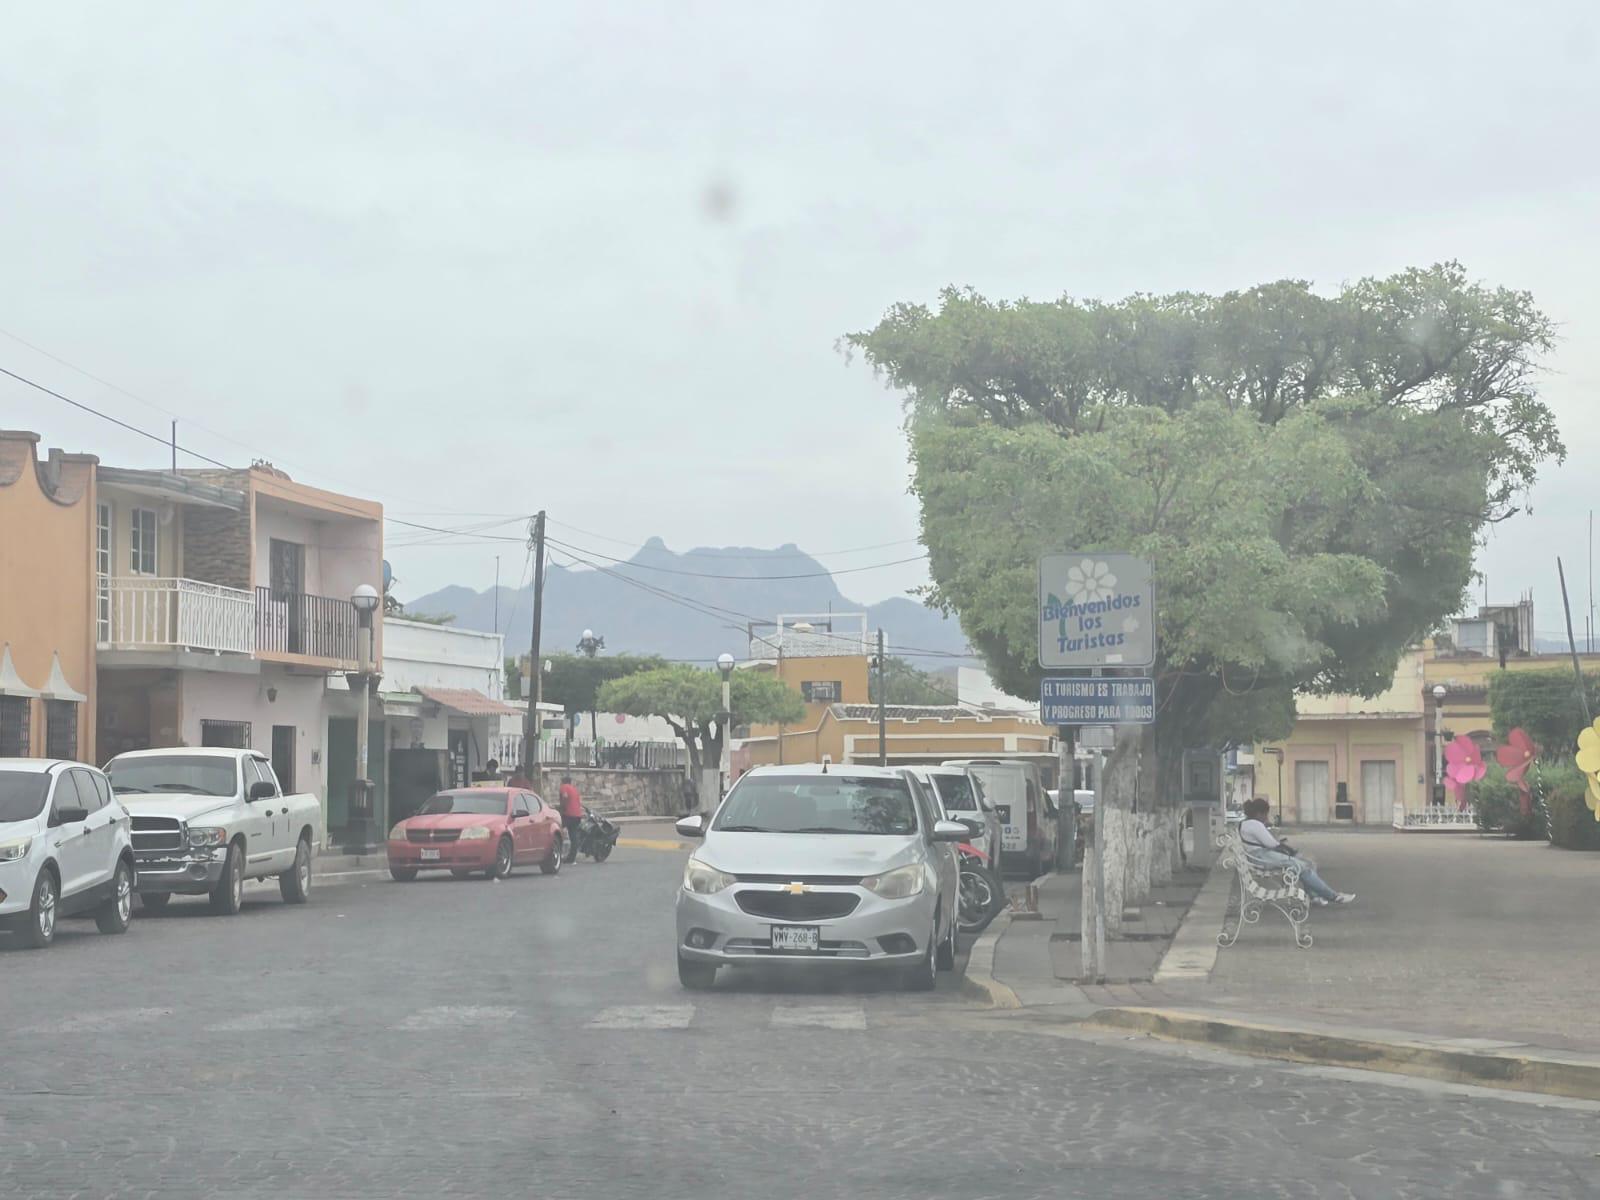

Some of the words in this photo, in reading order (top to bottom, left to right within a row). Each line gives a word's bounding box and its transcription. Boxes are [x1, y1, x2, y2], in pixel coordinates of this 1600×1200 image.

[1043, 594, 1140, 621] Bienvenidos
[1078, 615, 1102, 632] los
[1057, 632, 1125, 653] Turistas
[1044, 683, 1053, 697] EL
[1056, 683, 1095, 697] TURISMO
[1098, 683, 1108, 697] ES
[1112, 683, 1151, 697] TRABAJO
[1044, 705, 1051, 719] Y
[1052, 705, 1096, 719] PROGRESO
[1098, 705, 1121, 719] PARA
